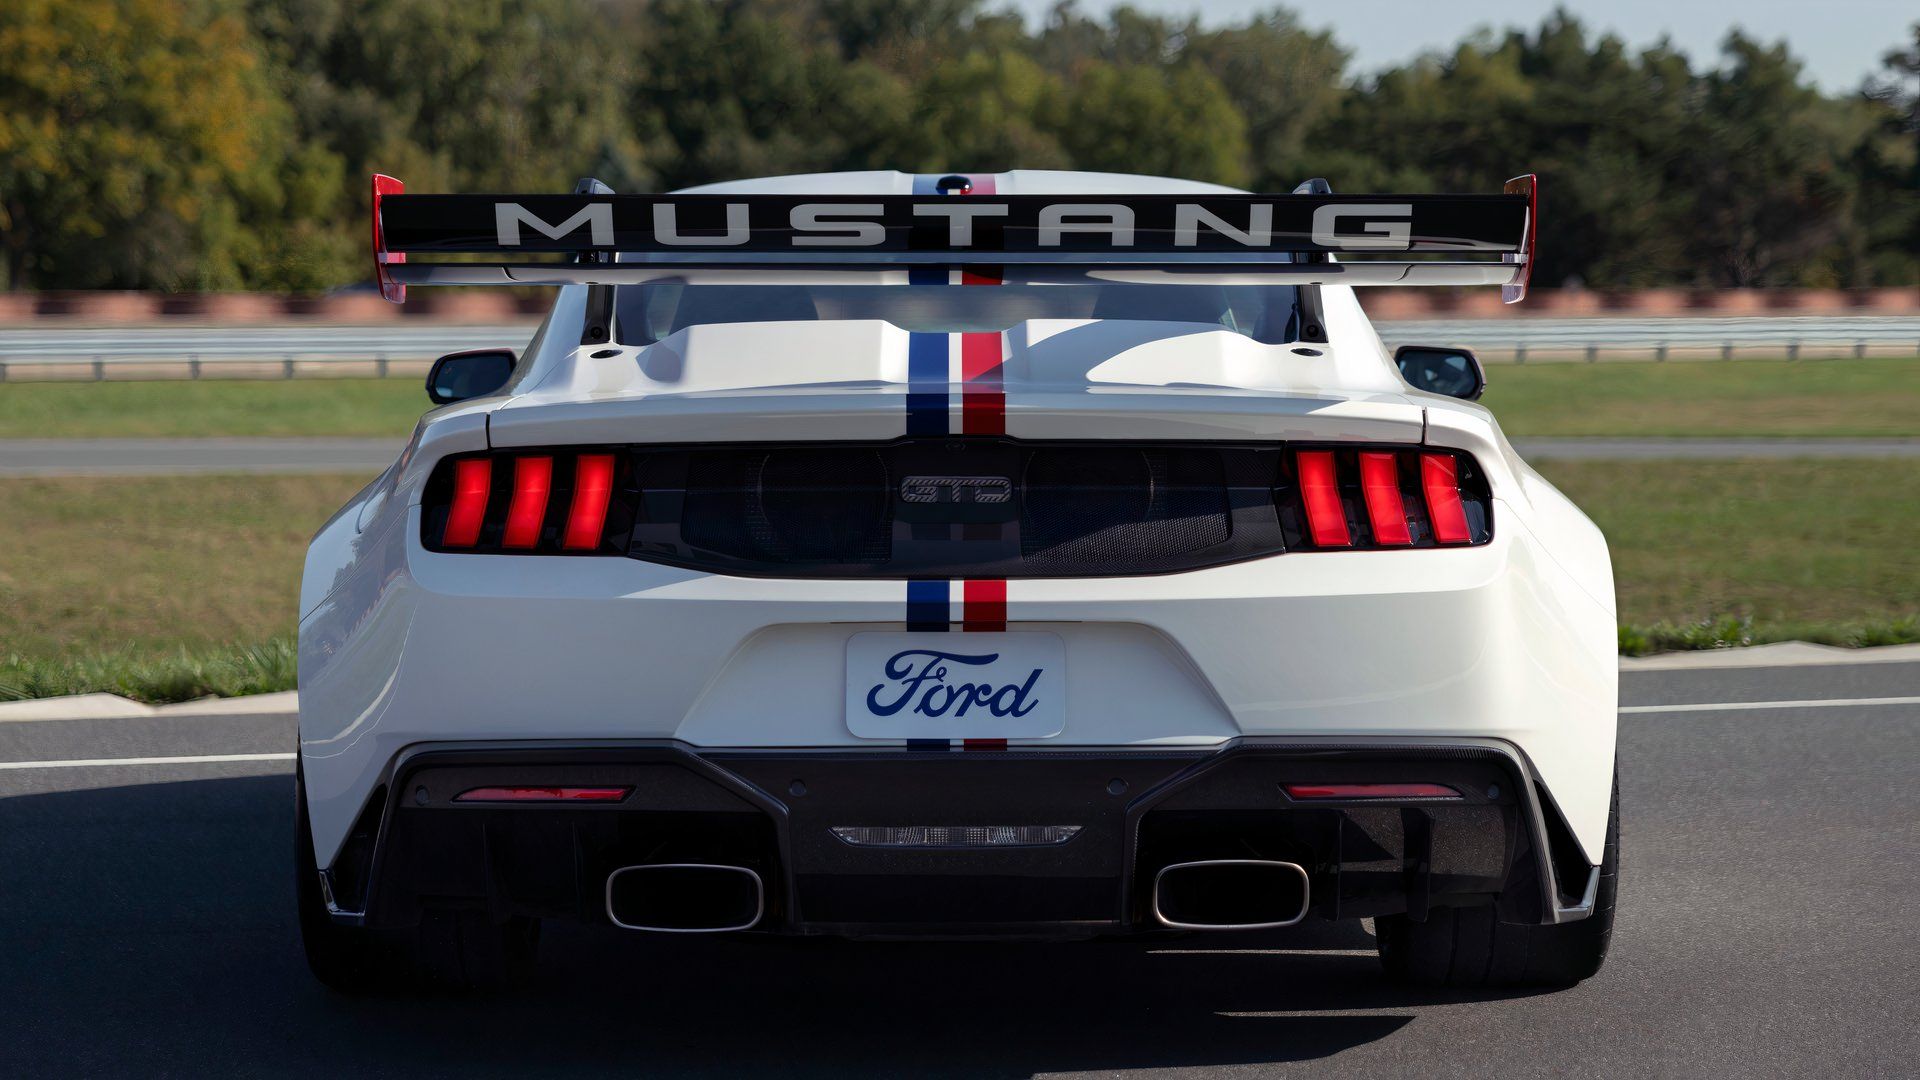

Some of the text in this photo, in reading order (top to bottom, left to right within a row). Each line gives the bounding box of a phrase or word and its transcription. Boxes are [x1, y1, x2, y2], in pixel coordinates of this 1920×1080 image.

[494, 202, 1413, 247] MUSTANG
[901, 475, 1012, 503] GTD
[866, 650, 1043, 718] Ford
